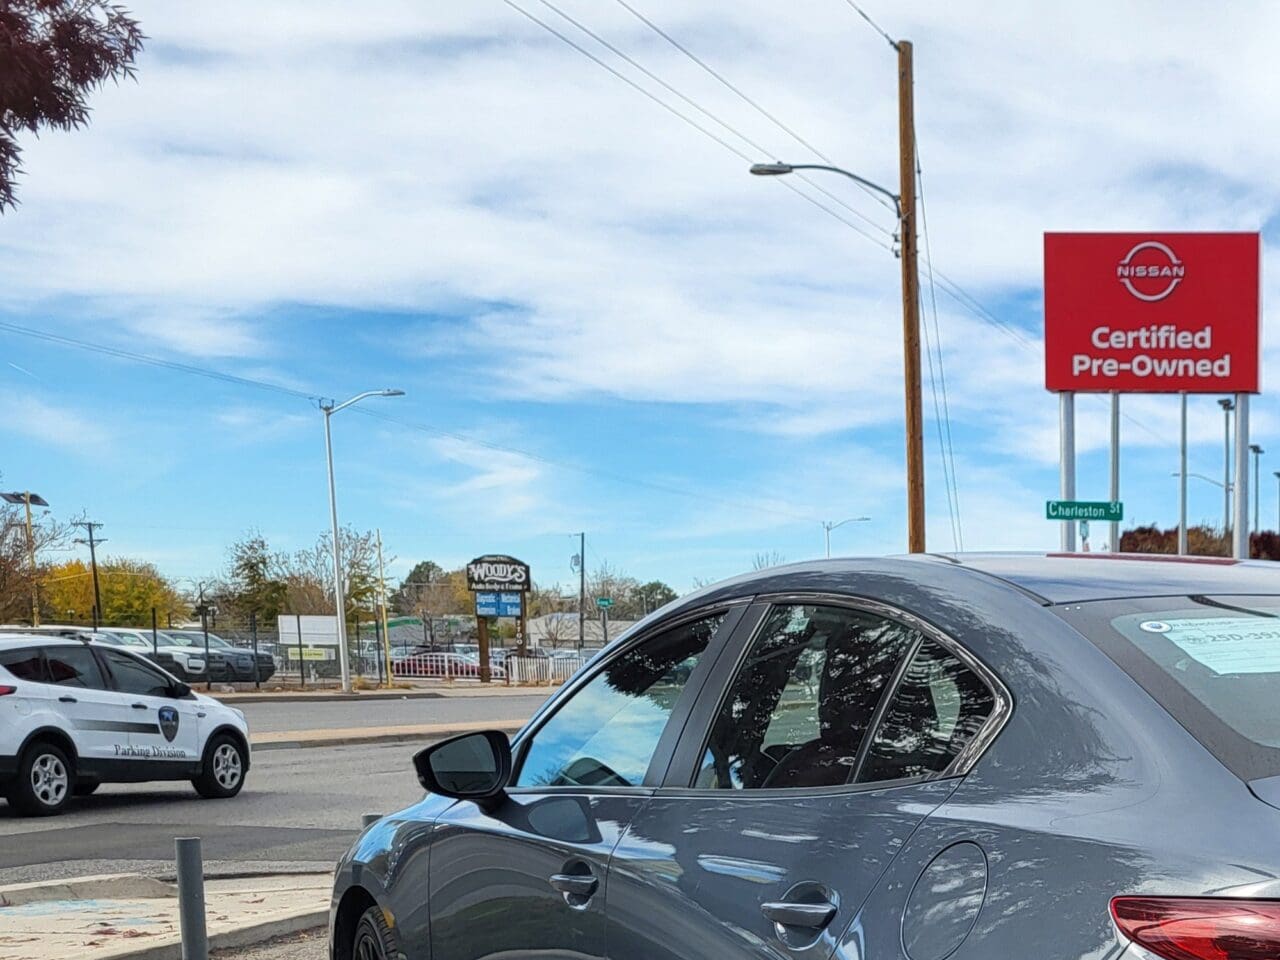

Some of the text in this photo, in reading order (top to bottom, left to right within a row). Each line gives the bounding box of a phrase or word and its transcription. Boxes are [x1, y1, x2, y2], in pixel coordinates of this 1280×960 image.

[1117, 265, 1185, 277] NISSAN
[1091, 325, 1212, 349] Certified
[1072, 354, 1231, 377] Pre-Owned
[1049, 502, 1121, 517] Charleston St
[114, 744, 186, 759] Parking Division
